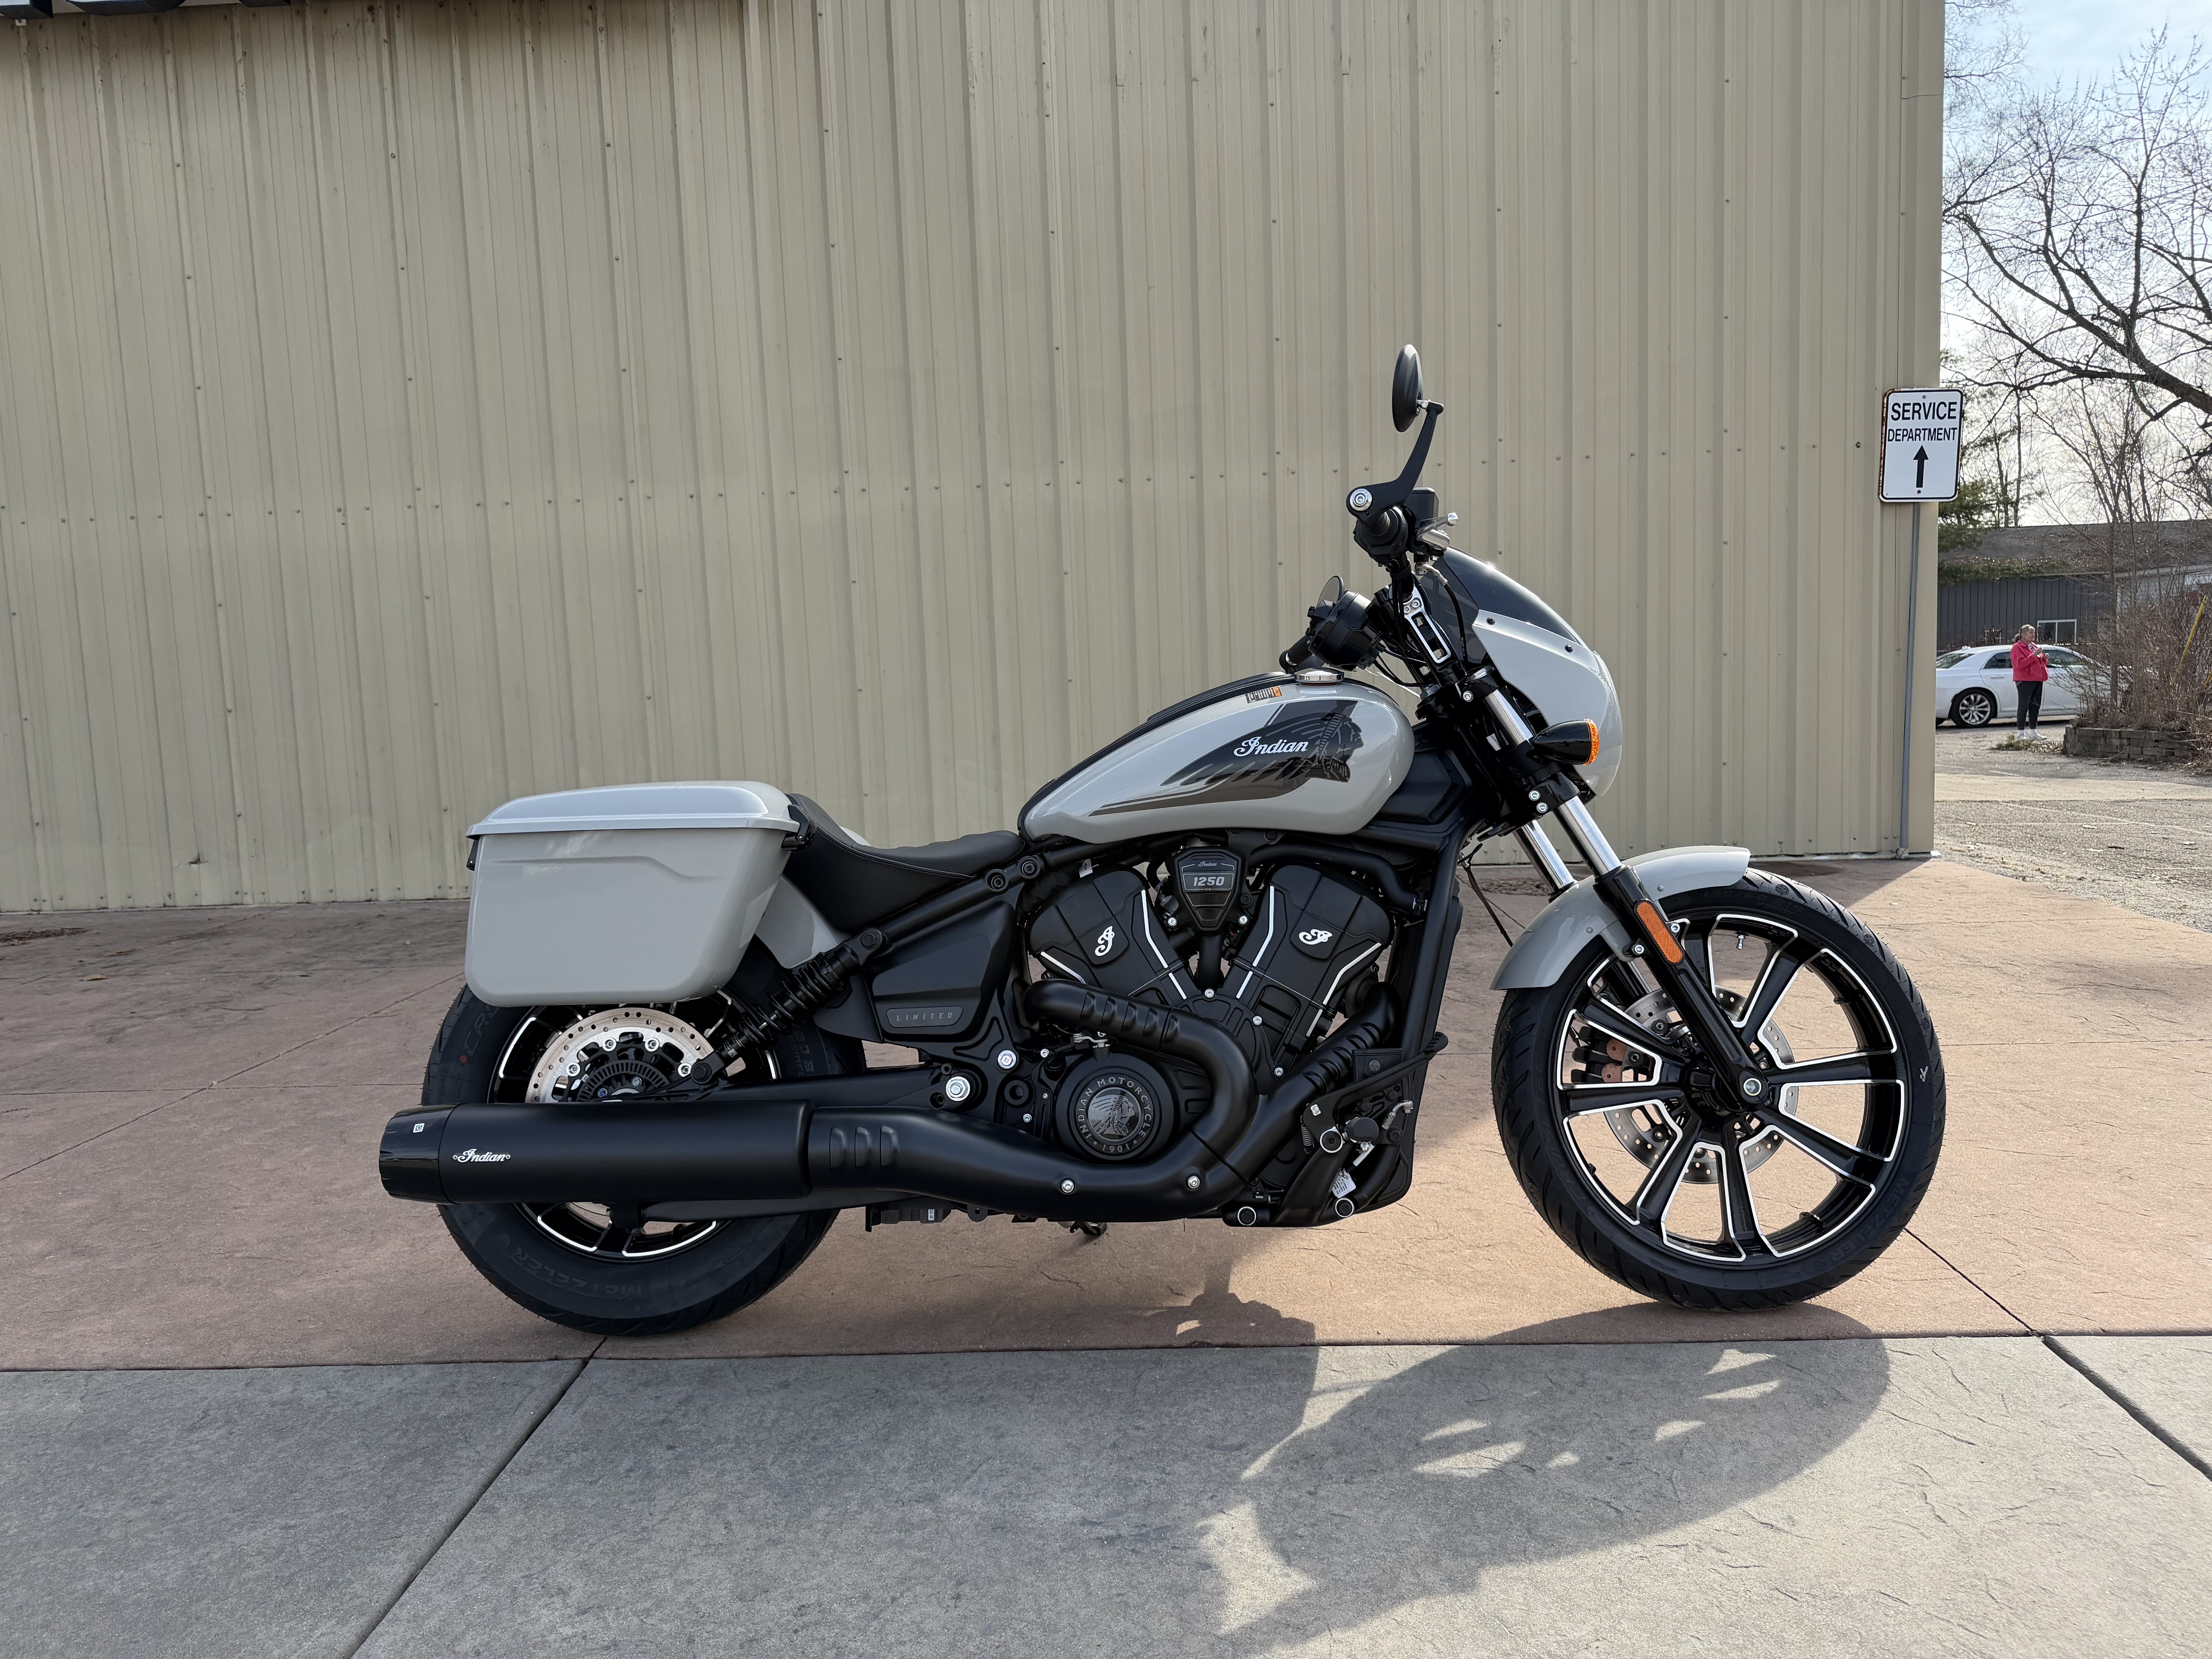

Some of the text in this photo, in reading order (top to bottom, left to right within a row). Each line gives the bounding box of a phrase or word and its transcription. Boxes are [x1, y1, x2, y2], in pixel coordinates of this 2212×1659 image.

[1891, 401, 1957, 421] SERVICE
[1887, 427, 1958, 442] DEPARTMENT
[1233, 736, 1309, 757] Indian
[1193, 876, 1225, 886] 1250
[896, 1012, 953, 1021] LIMITED
[1078, 1077, 1152, 1139] INDIAN MOTORCYCLE
[457, 1149, 506, 1163] Indian
[1102, 1143, 1130, 1153] 1901
[1830, 1177, 1909, 1262] METZELER
[510, 1247, 642, 1299] METZELER
